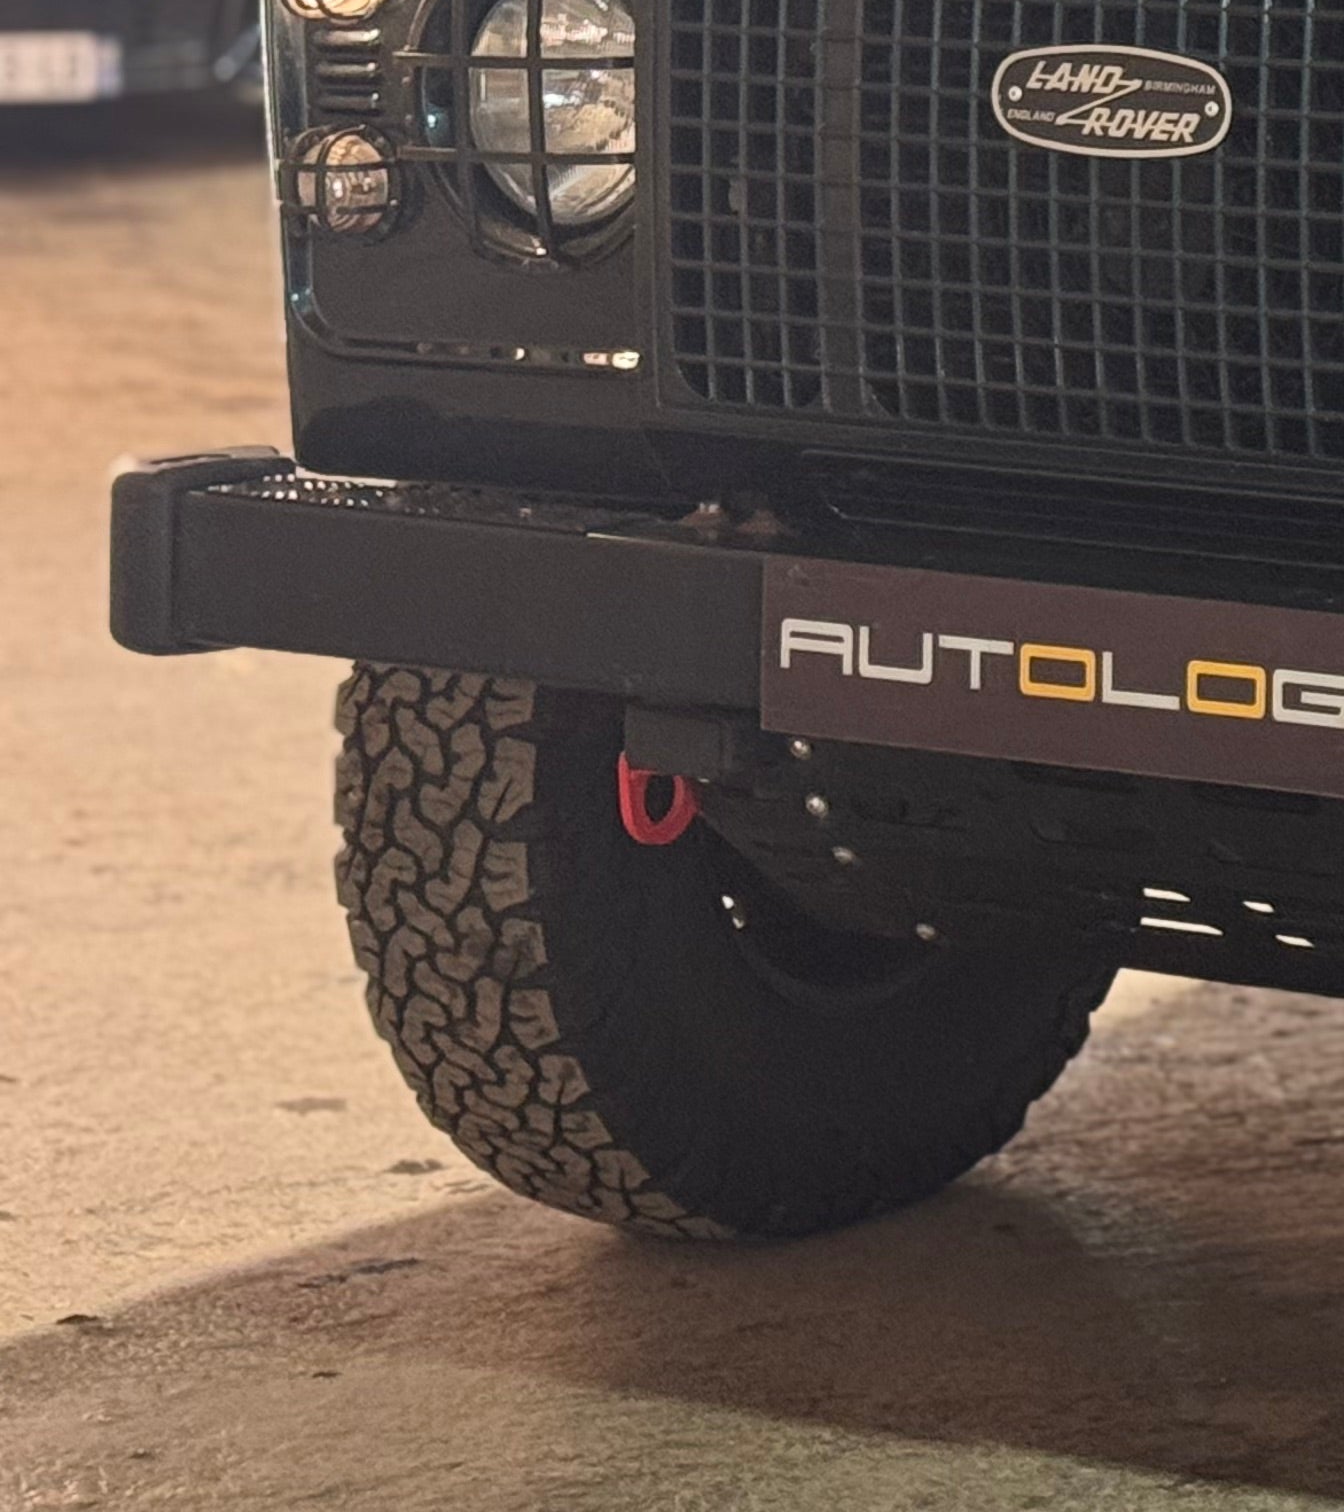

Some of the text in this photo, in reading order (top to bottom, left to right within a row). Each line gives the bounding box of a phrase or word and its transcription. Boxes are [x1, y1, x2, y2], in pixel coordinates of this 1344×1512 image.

[1025, 60, 1216, 96] LAND BIRMINGHAM
[1080, 106, 1201, 143] ROVER
